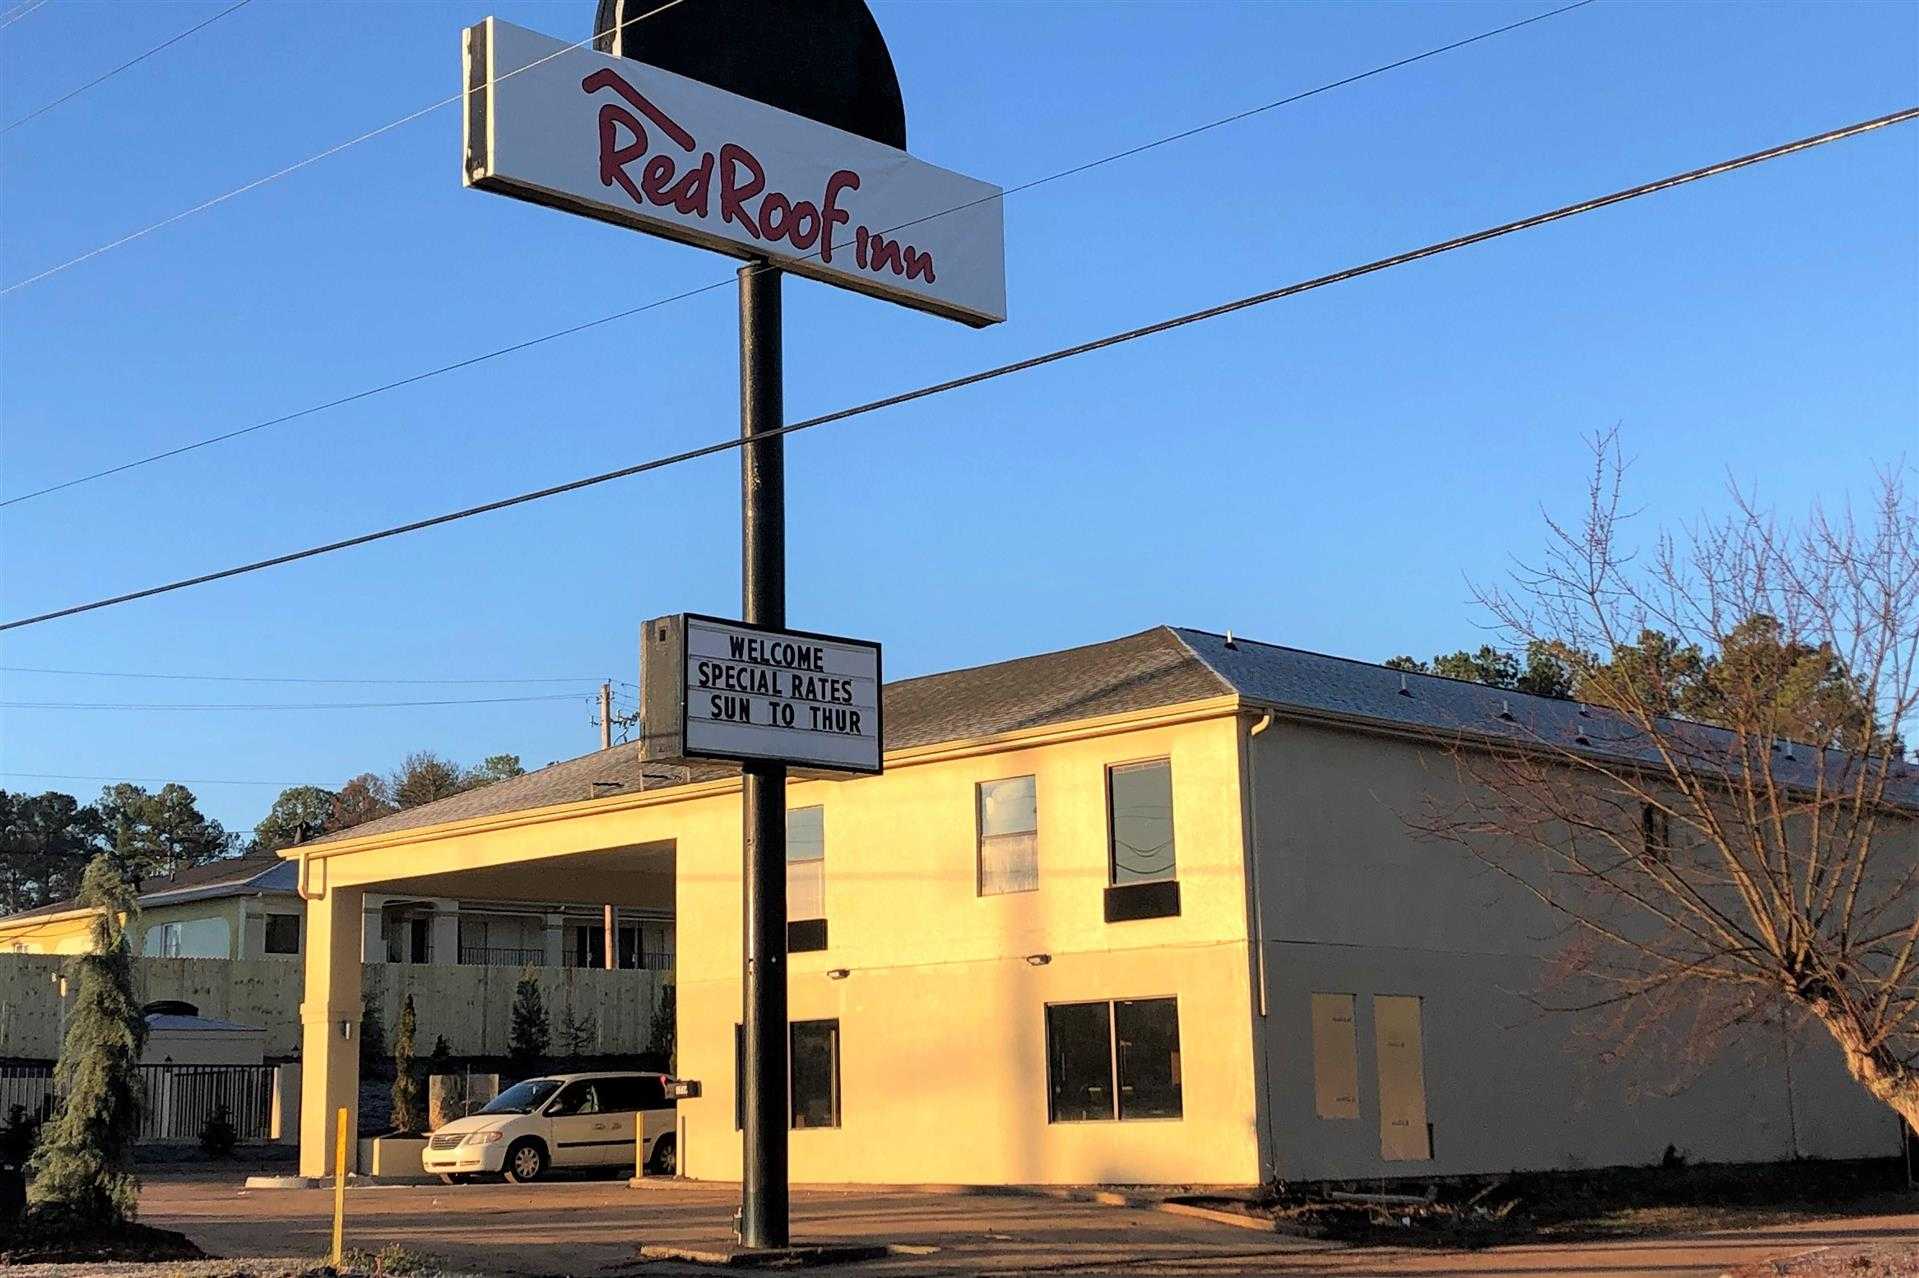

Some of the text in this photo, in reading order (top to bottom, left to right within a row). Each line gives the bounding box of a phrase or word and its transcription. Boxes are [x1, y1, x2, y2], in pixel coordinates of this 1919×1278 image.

[730, 636, 824, 672] WELCOME
[698, 662, 853, 704] SPECIAL RATES
[711, 695, 862, 735] SUN TO THUR
